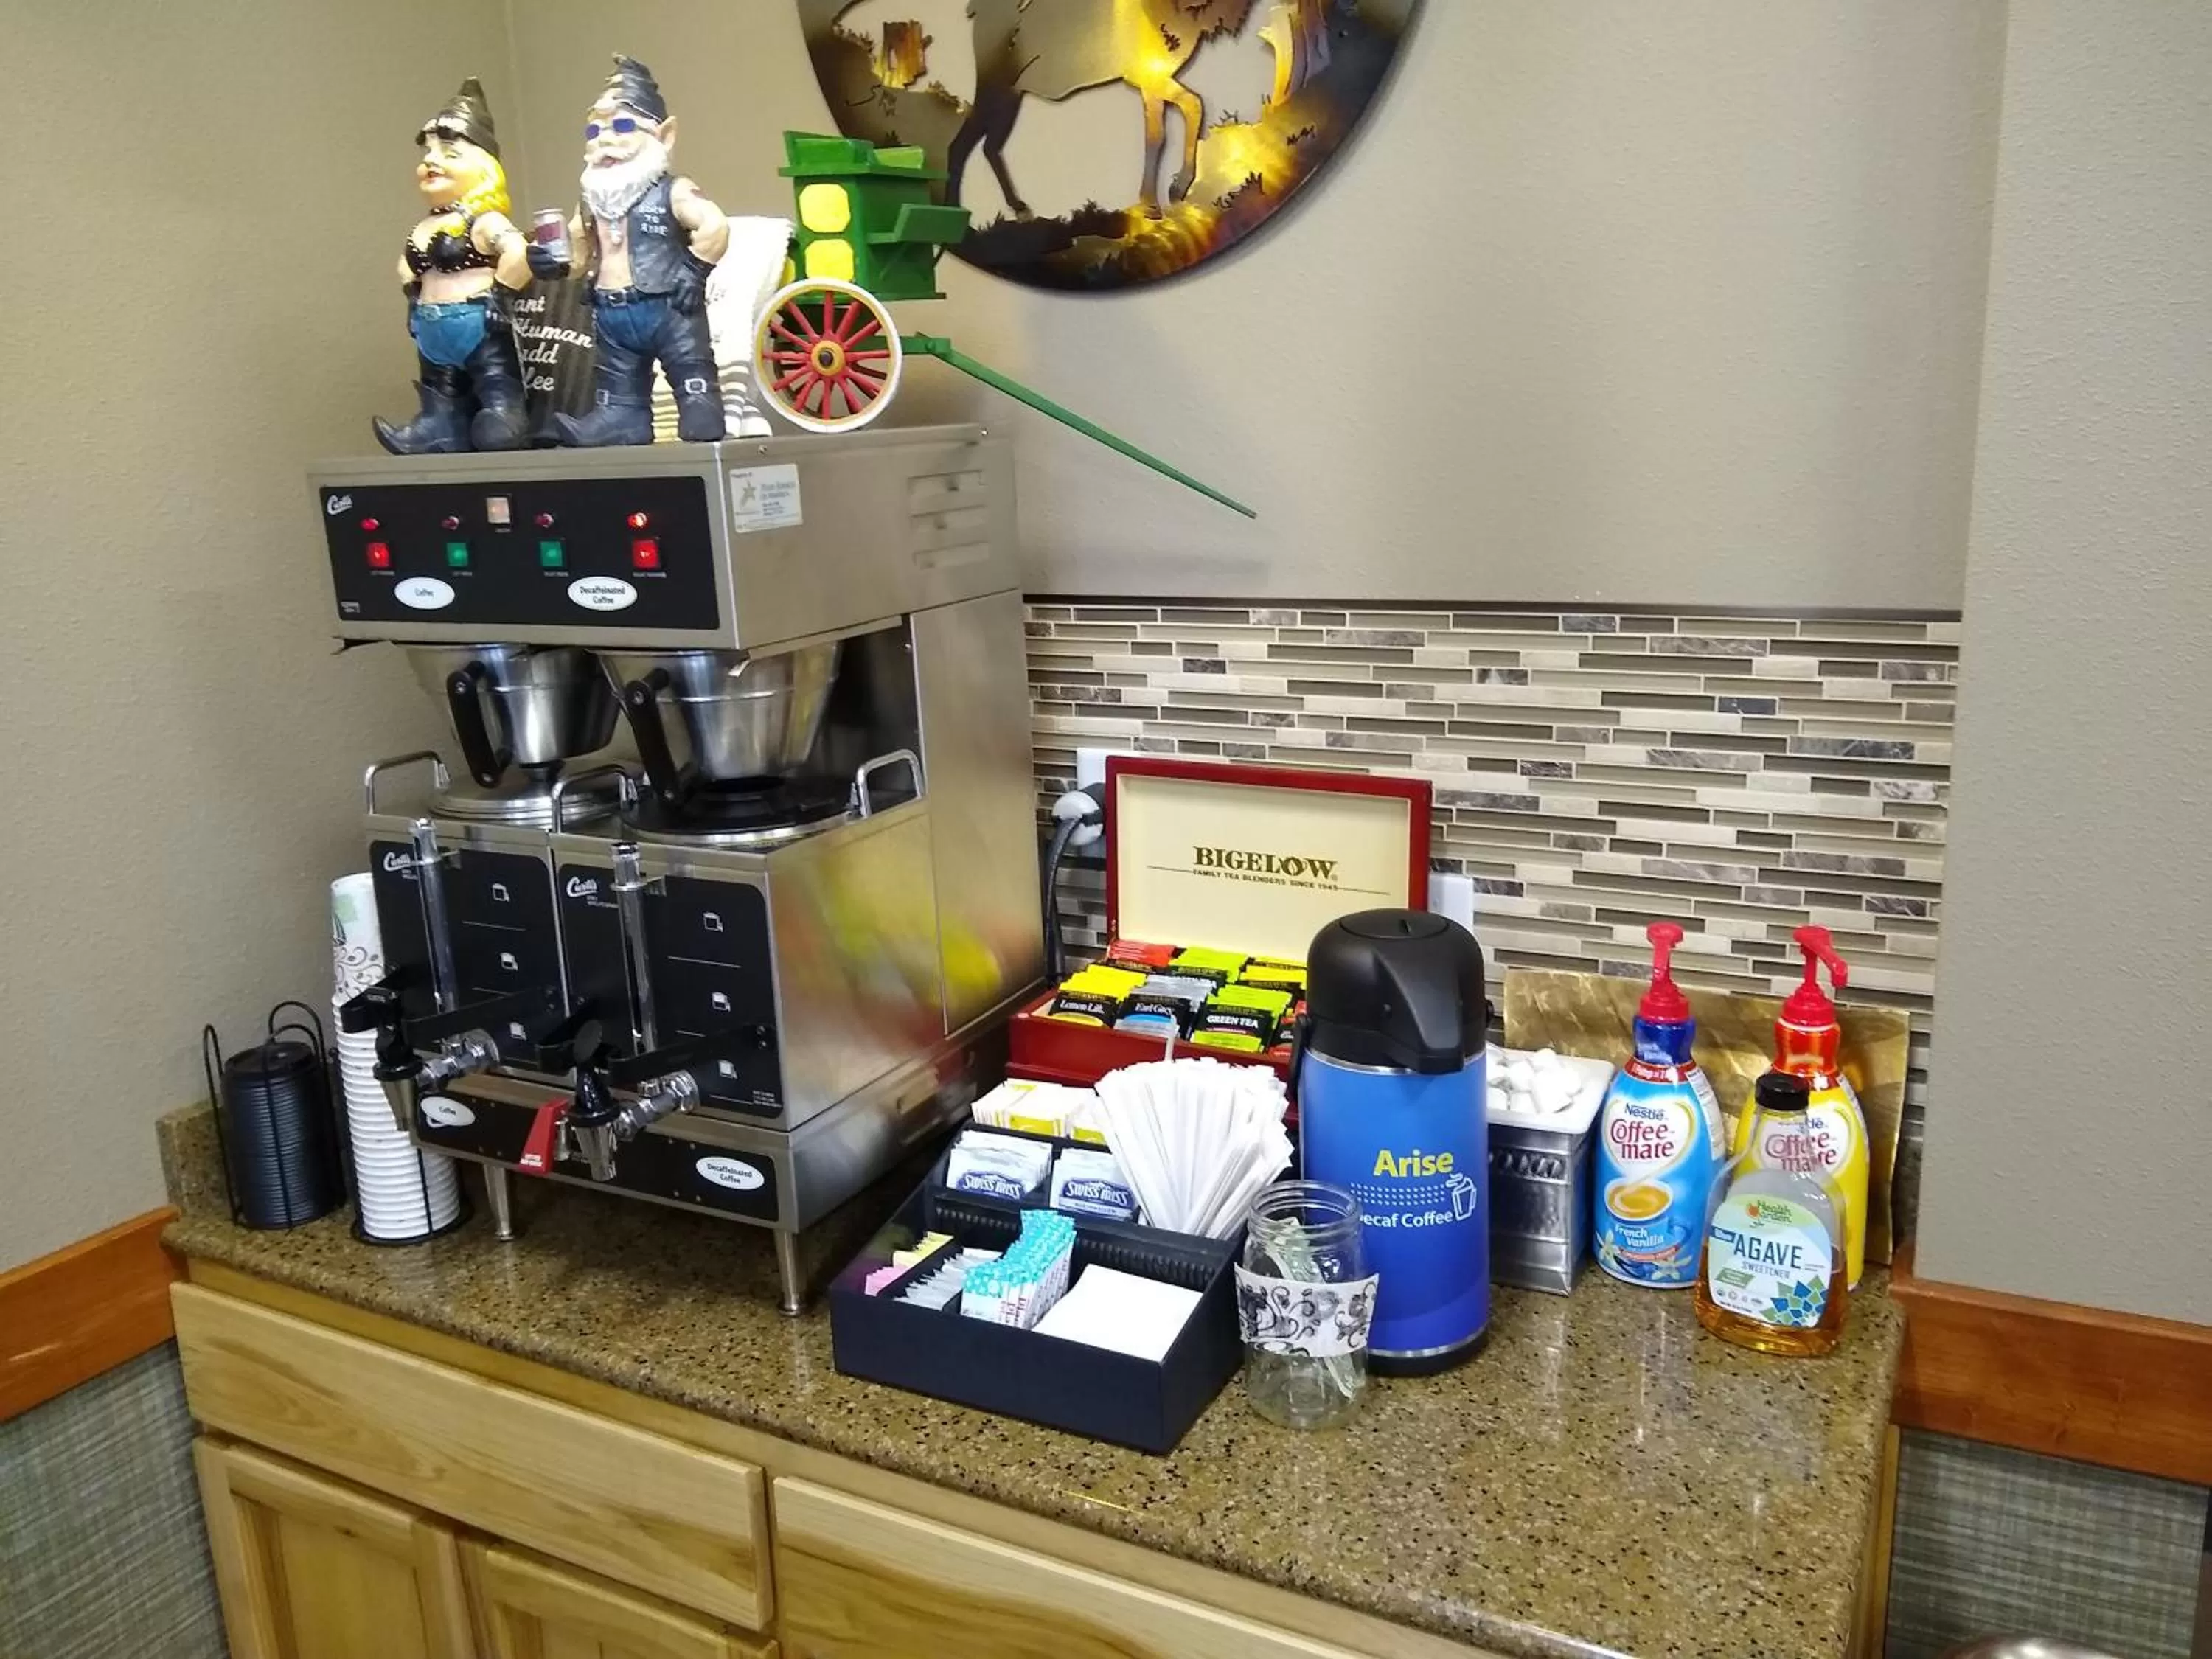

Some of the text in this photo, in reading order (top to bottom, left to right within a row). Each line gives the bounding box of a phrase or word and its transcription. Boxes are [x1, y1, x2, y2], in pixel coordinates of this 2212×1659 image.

[580, 585, 625, 595] Decaffeinated
[593, 595, 614, 605] Coffee
[1192, 846, 1338, 880] BIGELOW
[1192, 869, 1221, 878] FAMILY
[1225, 872, 1239, 880] TEA
[1242, 874, 1287, 886] BLENDERS
[1290, 880, 1315, 888] SINCE
[1206, 1014, 1259, 1029] GREEN TEA
[1610, 1118, 1669, 1144] Coffee
[1621, 1141, 1674, 1160] mate
[1374, 1149, 1454, 1178] Arise
[1360, 1211, 1453, 1228] ecaf Coffee
[1615, 1224, 1648, 1238] French
[1733, 1234, 1803, 1269] AGAVE
